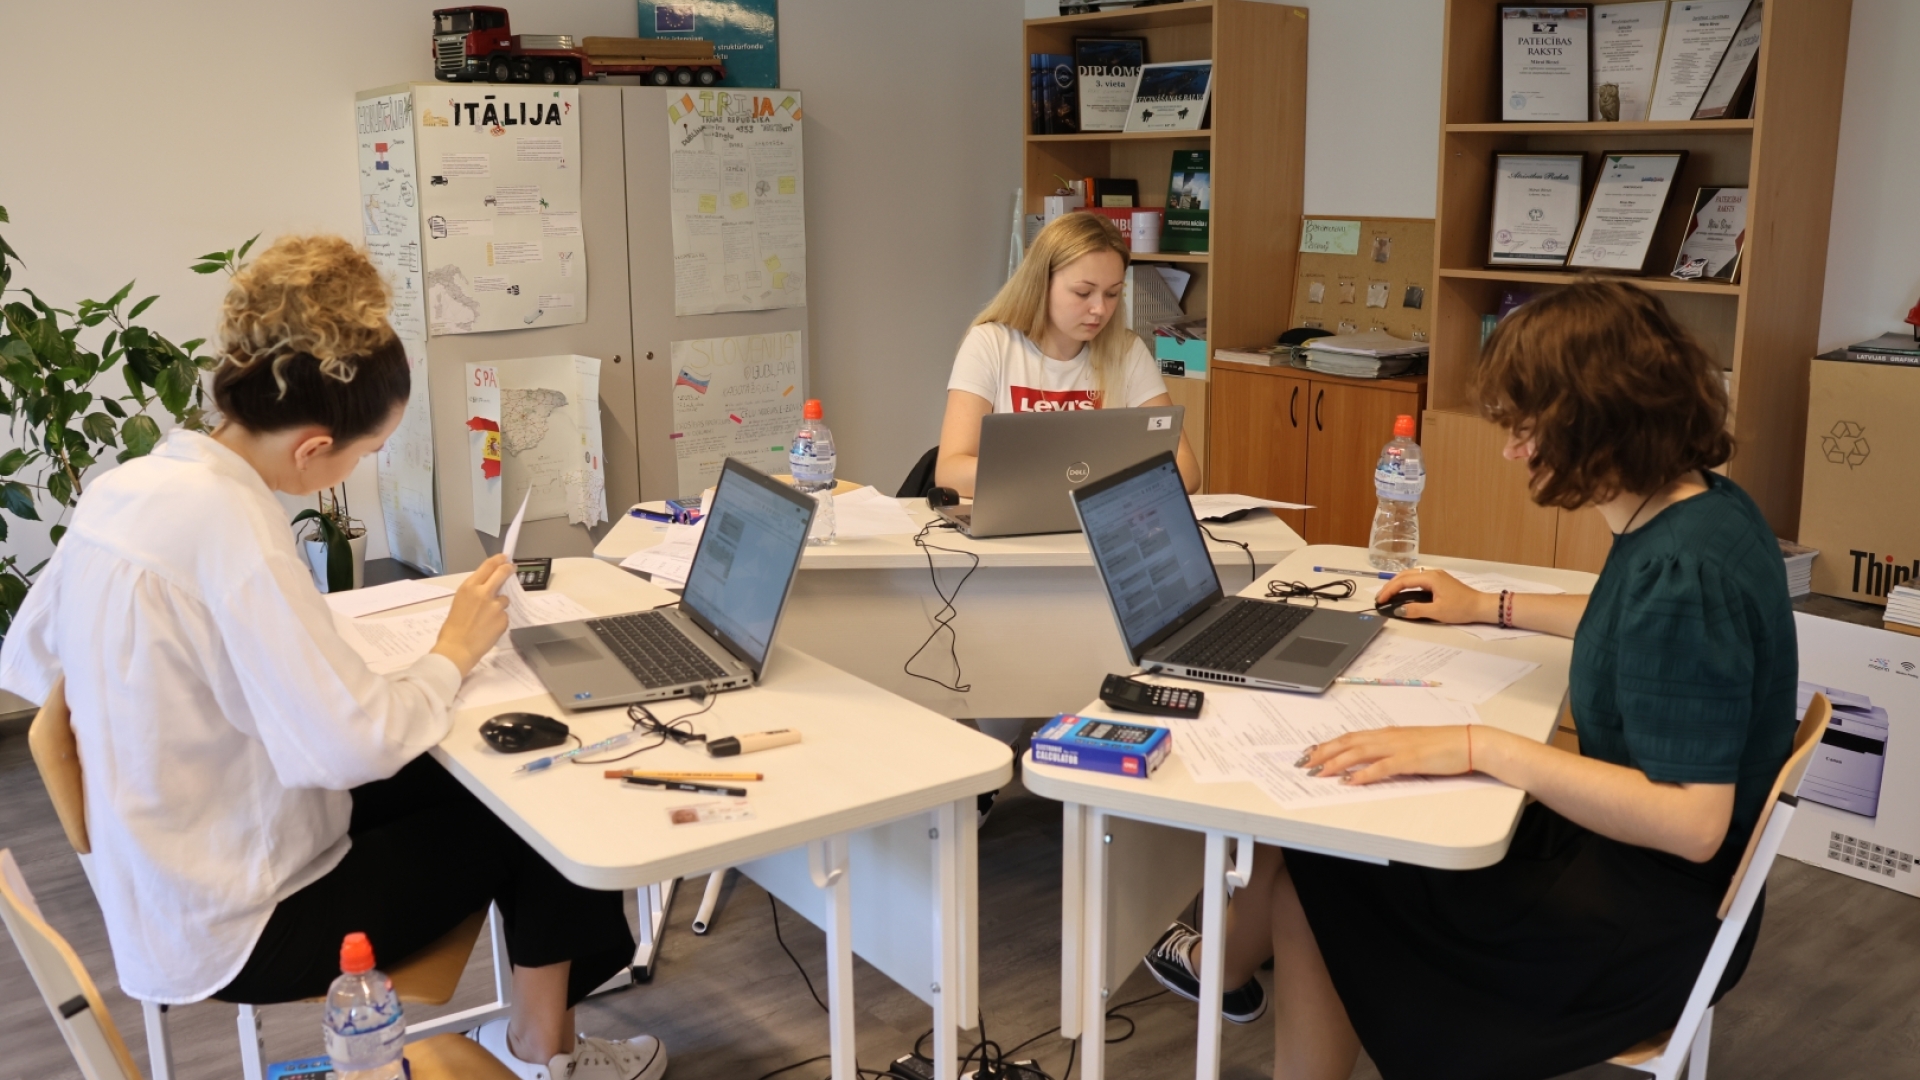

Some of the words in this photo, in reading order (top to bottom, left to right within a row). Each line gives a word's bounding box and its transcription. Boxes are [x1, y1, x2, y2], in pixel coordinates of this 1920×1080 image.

[1517, 36, 1573, 46] PATEICĪBAS
[1527, 47, 1563, 56] RAKSTS
[1078, 65, 1141, 78] DIPLOMS
[1105, 79, 1126, 88] vieta
[453, 95, 562, 126] ITĀLIJA
[1857, 353, 1886, 362] LATVIJAS
[1889, 355, 1918, 363] GRAFIKA
[1035, 750, 1078, 765] CALCULATOR
